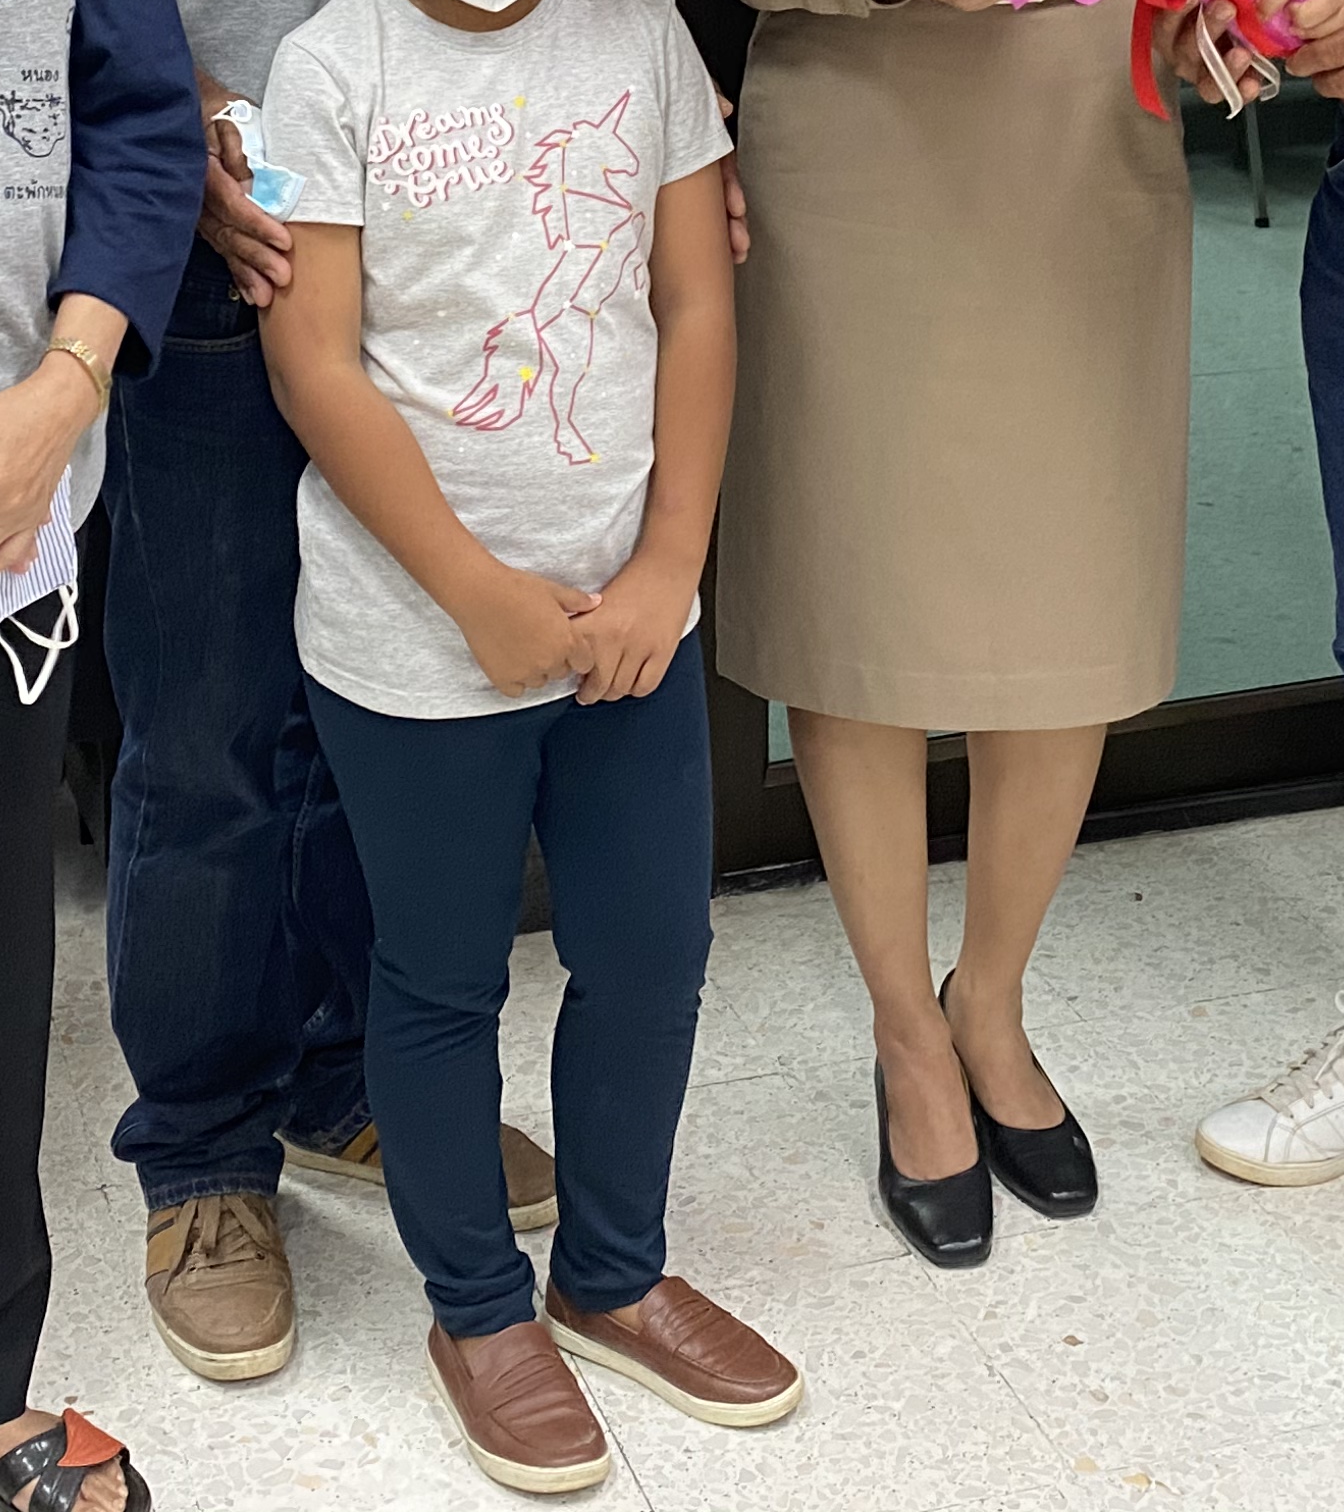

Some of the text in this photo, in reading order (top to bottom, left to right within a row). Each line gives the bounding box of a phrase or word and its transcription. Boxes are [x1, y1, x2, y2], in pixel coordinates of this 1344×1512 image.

[20, 67, 60, 83] หนอง
[367, 102, 515, 165] Dreams
[392, 134, 500, 176] come
[368, 159, 516, 209] true
